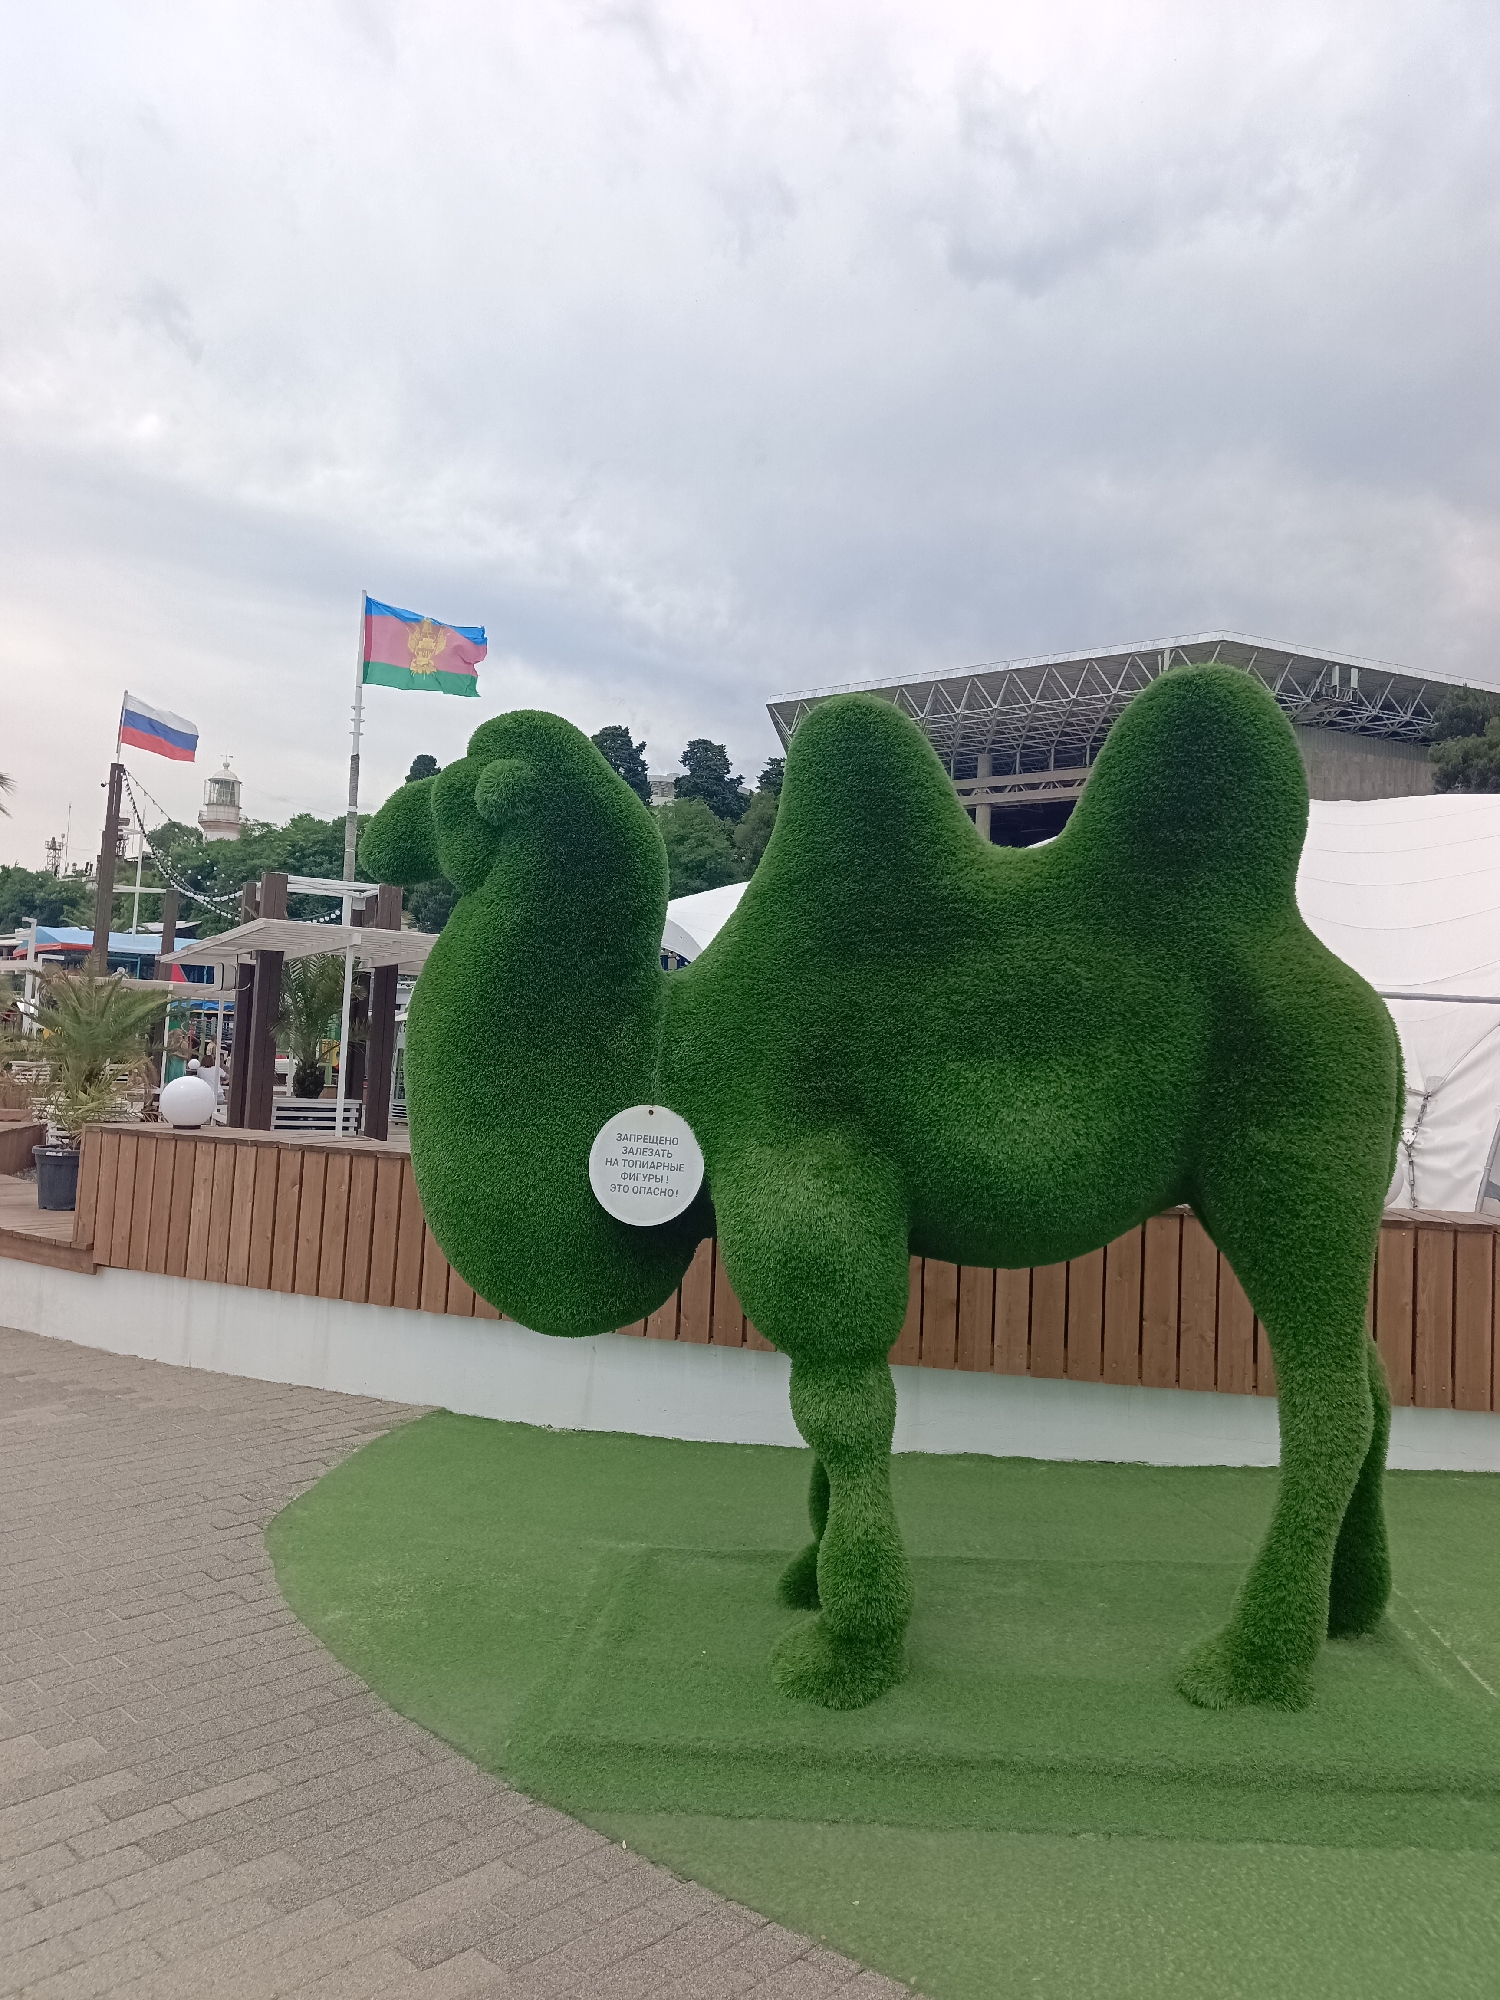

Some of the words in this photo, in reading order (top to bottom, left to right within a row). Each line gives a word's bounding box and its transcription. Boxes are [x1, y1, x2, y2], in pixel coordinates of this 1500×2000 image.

[616, 1133, 679, 1146] ЗАПРЕЩЕНО
[622, 1146, 673, 1158] ЗАЛЕЗАТЬ
[605, 1158, 619, 1166] НА
[622, 1159, 685, 1172] ТОПИАРНЫЕ
[610, 1184, 629, 1193] ЭТО
[632, 1186, 679, 1198] ОПАСНО!
